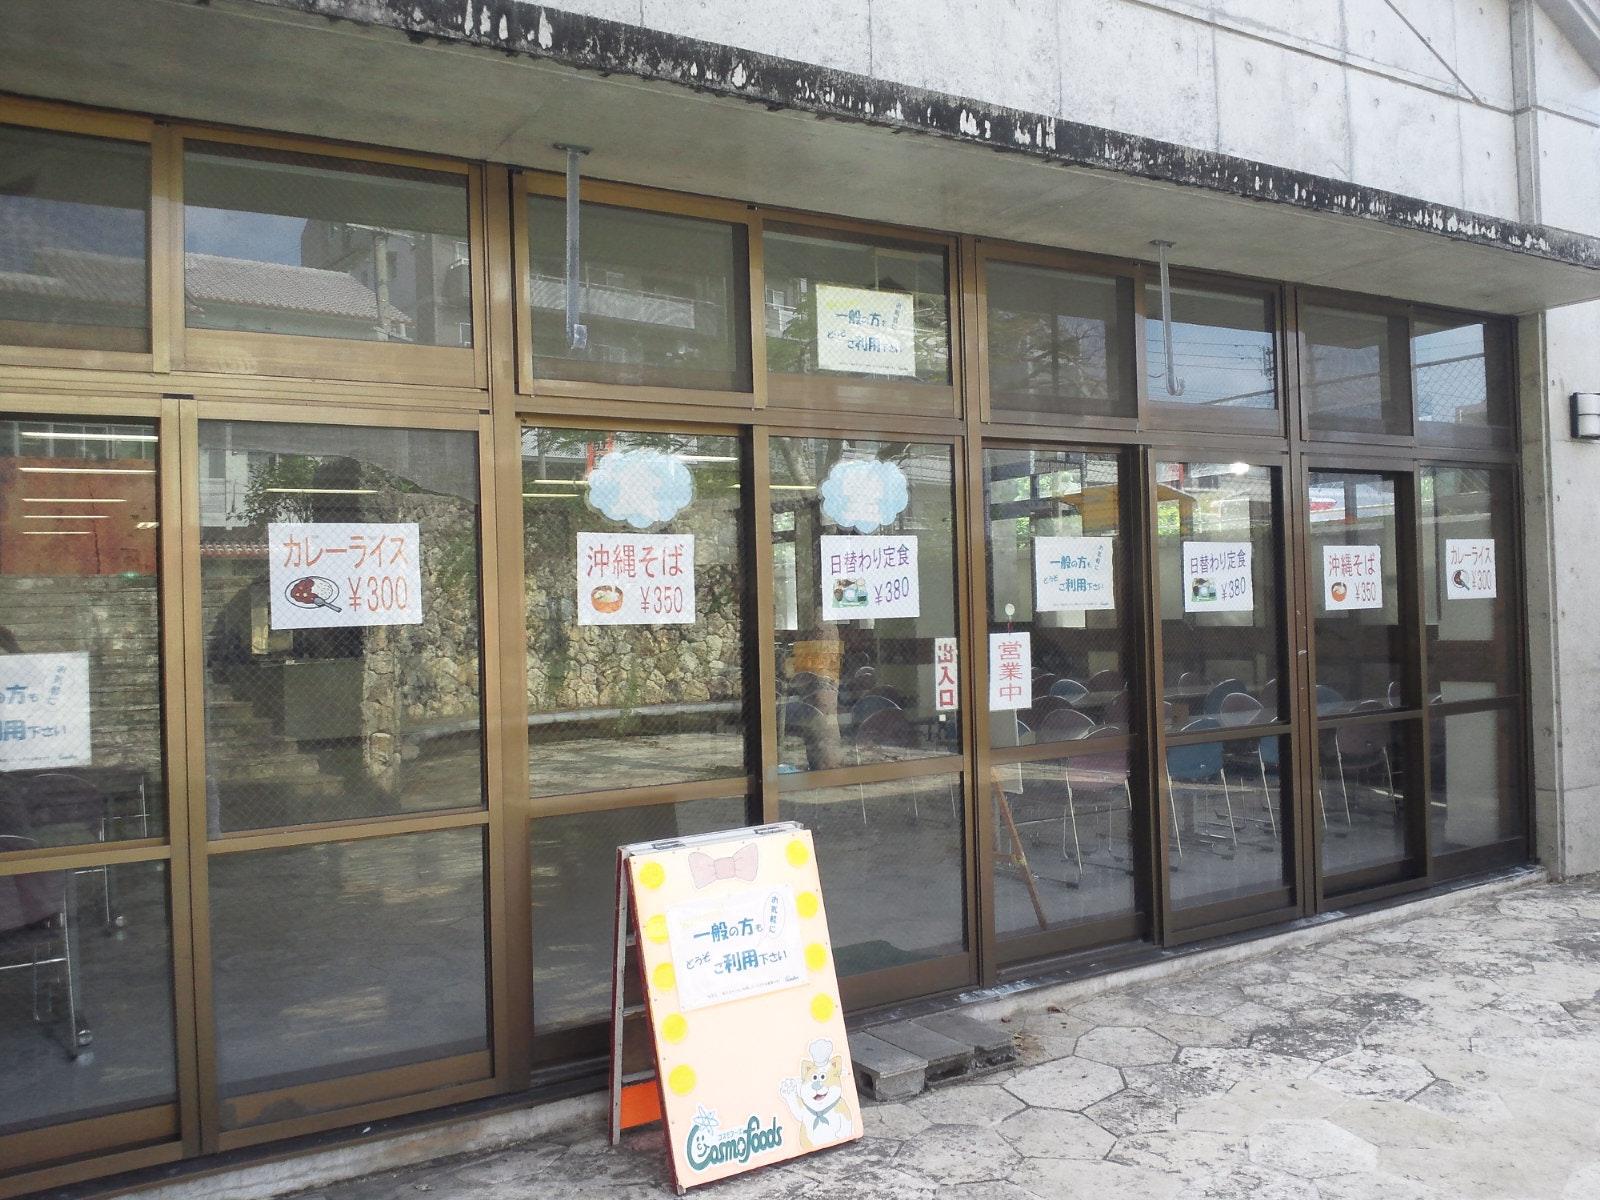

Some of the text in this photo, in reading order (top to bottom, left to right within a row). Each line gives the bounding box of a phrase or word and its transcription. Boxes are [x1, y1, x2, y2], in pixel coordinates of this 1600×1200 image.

[283, 534, 409, 569] カレーライス
[586, 543, 685, 578] 沖縄そば
[830, 543, 910, 576] 日替わり定食
[1191, 549, 1247, 574] 日替わり定食
[1329, 553, 1376, 577] 沖縄そば
[1450, 545, 1492, 565] カレーライス
[348, 576, 409, 612] ¥300
[640, 585, 684, 615] ¥350
[874, 576, 910, 605] ¥380
[1221, 576, 1246, 600] ¥380
[1355, 582, 1376, 601] ¥350
[938, 643, 954, 708] 出入口
[998, 641, 1023, 702] 営業中
[693, 918, 764, 942] 一般の方も
[714, 949, 787, 974] ご利用下さい
